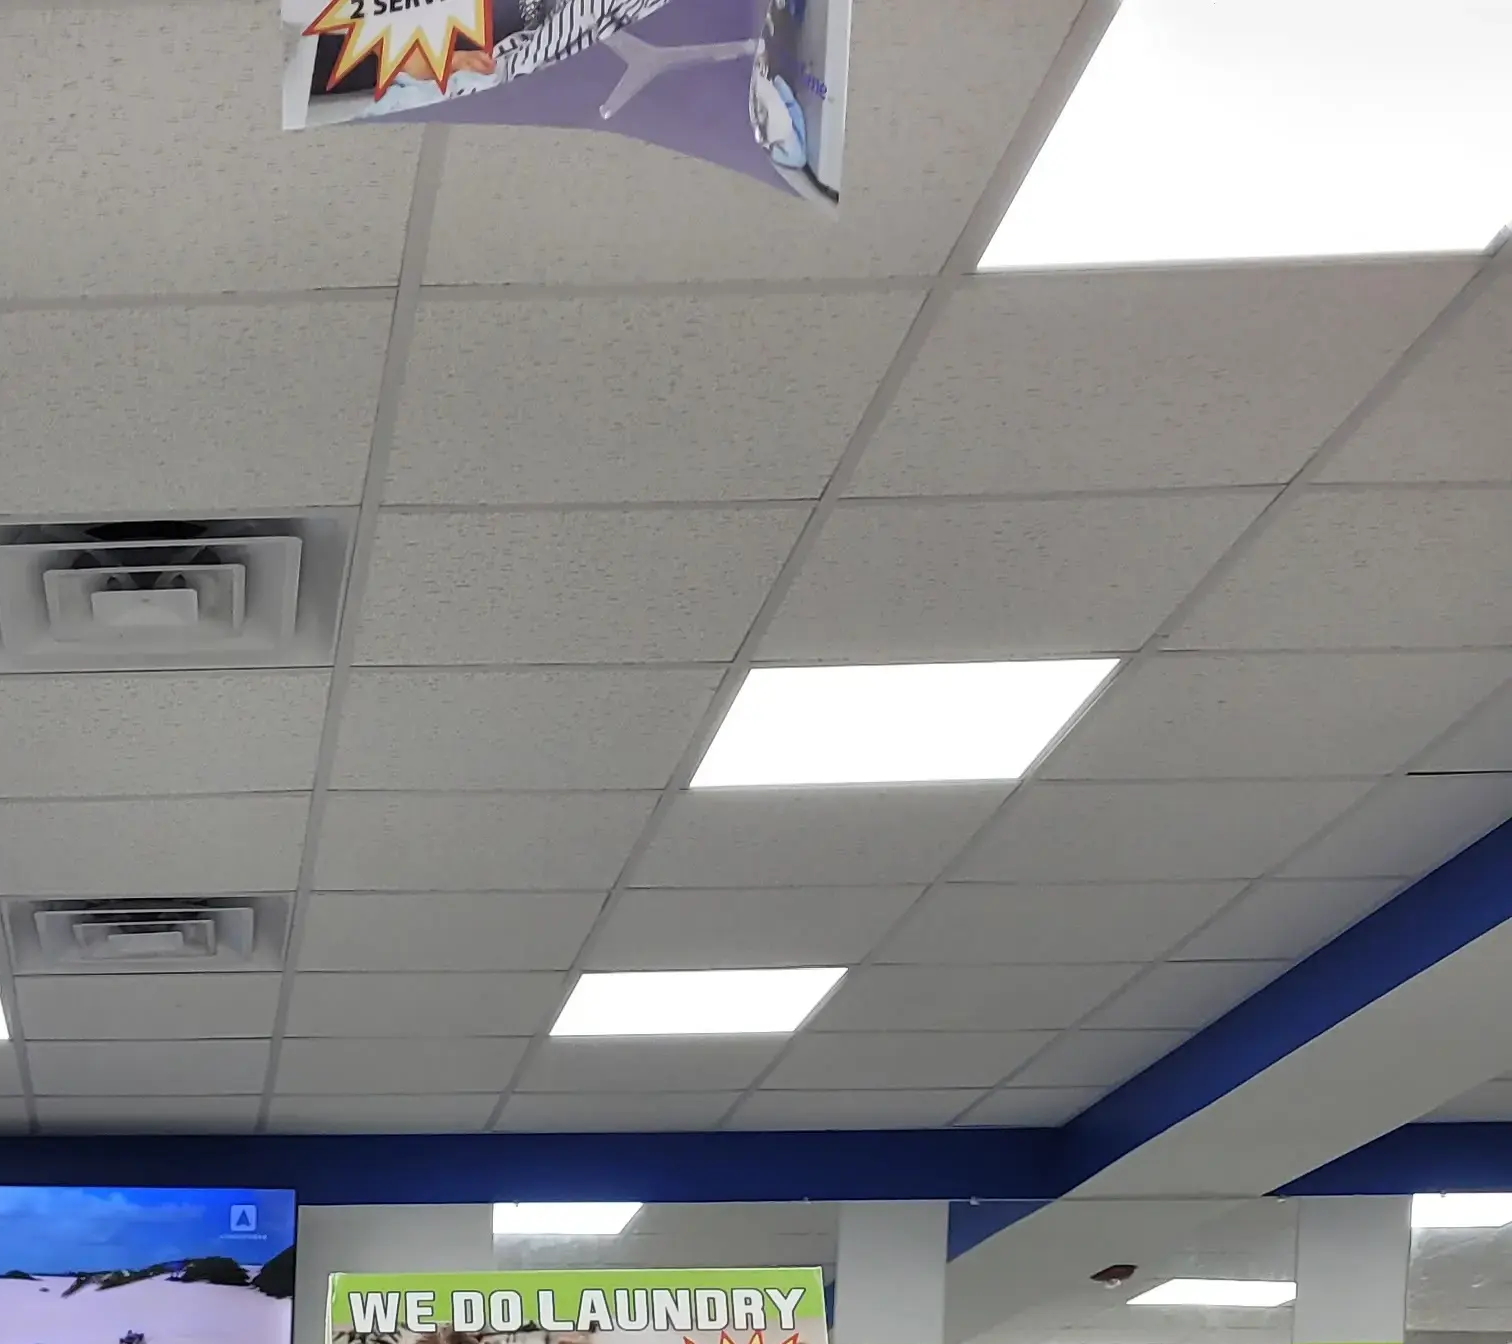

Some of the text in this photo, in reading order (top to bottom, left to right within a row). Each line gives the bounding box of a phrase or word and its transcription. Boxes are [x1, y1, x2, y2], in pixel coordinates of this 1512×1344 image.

[348, 1287, 807, 1334] WE DO LAUNDRY
